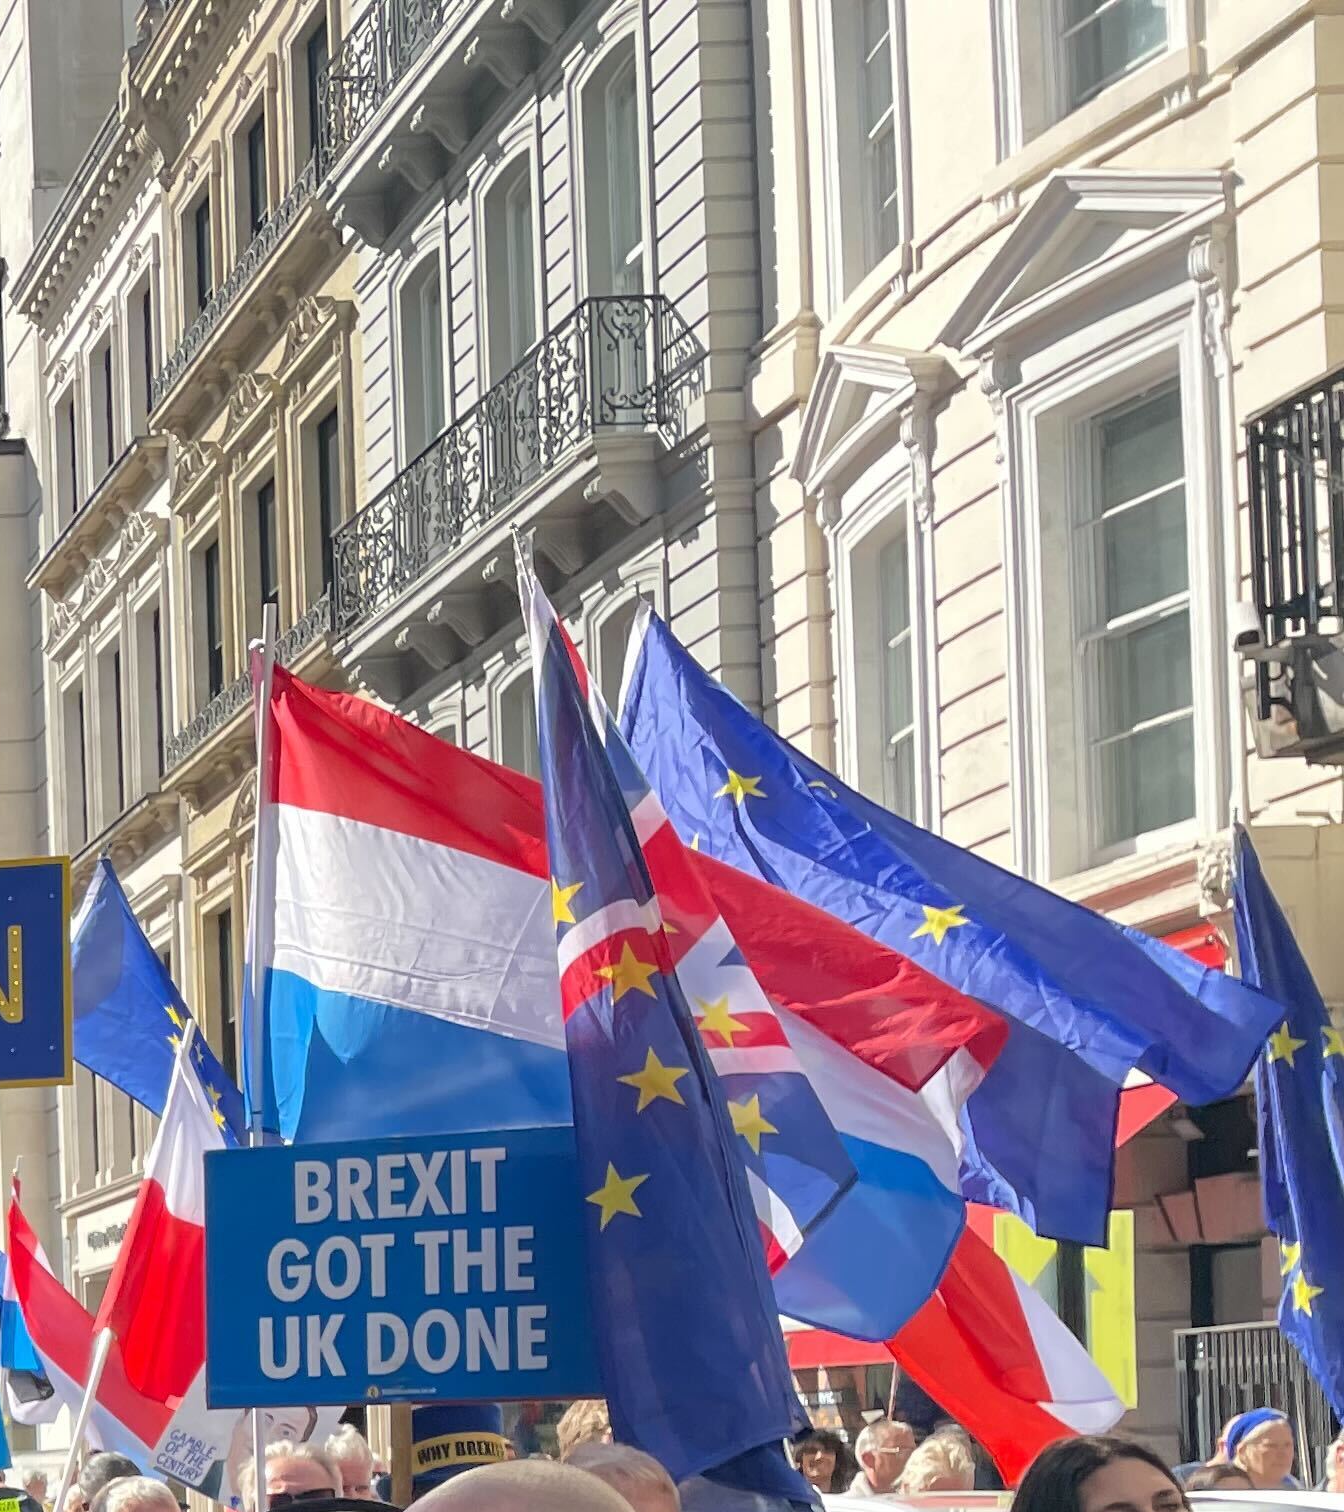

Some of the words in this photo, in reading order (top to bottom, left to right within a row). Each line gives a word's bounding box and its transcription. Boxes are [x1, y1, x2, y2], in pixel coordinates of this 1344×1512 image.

[294, 1147, 506, 1224] BREXIT
[267, 1232, 395, 1302] GOT
[414, 1225, 534, 1295] THE
[258, 1313, 347, 1380] UK
[366, 1304, 548, 1375] DONE
[156, 1452, 204, 1482] CENTURY
